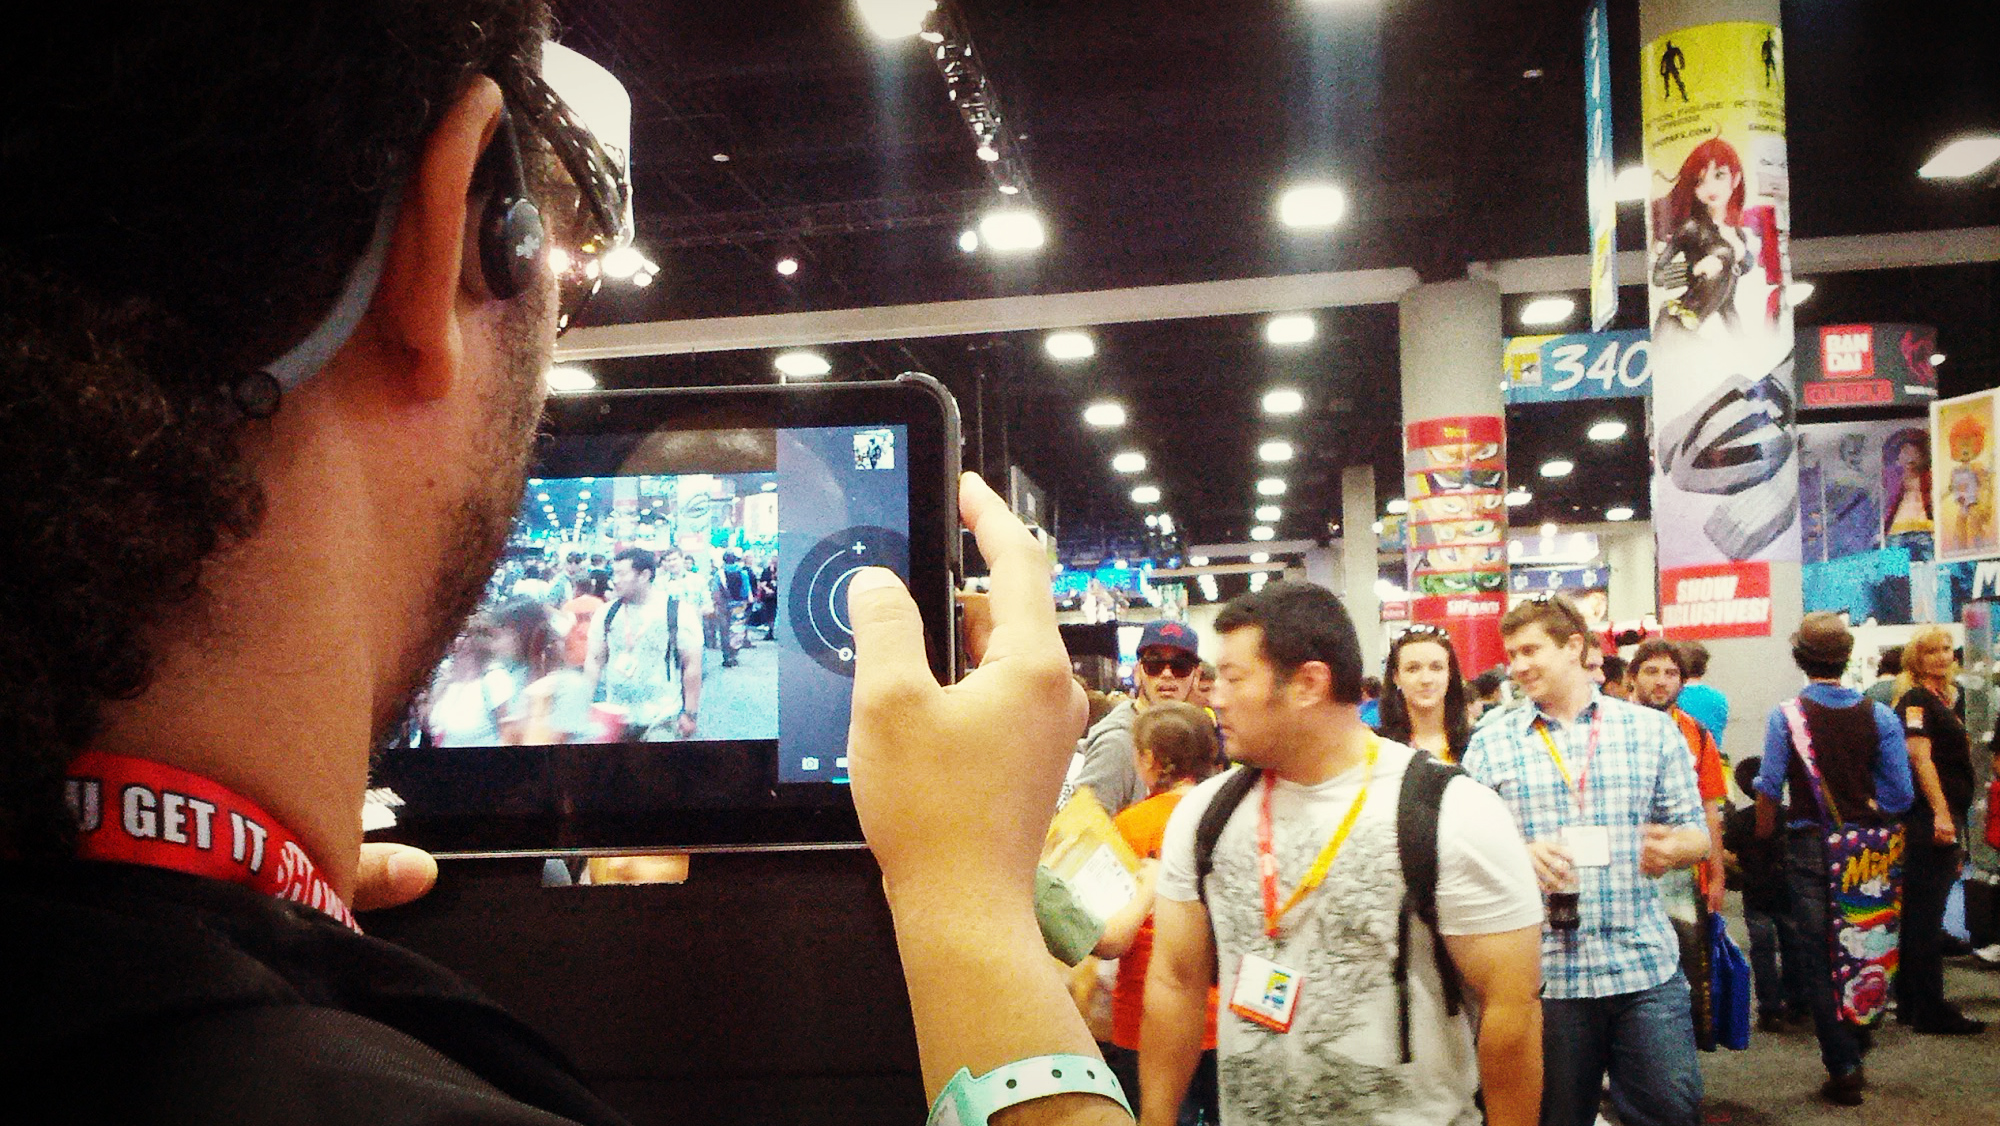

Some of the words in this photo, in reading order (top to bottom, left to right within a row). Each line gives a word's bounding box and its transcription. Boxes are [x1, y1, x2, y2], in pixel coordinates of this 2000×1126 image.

[1825, 333, 1868, 353] BAN
[1551, 340, 1652, 392] 340
[1826, 352, 1862, 372] DAI
[1677, 575, 1738, 603] SHOW
[123, 786, 215, 849] GET
[231, 812, 267, 872] IT
